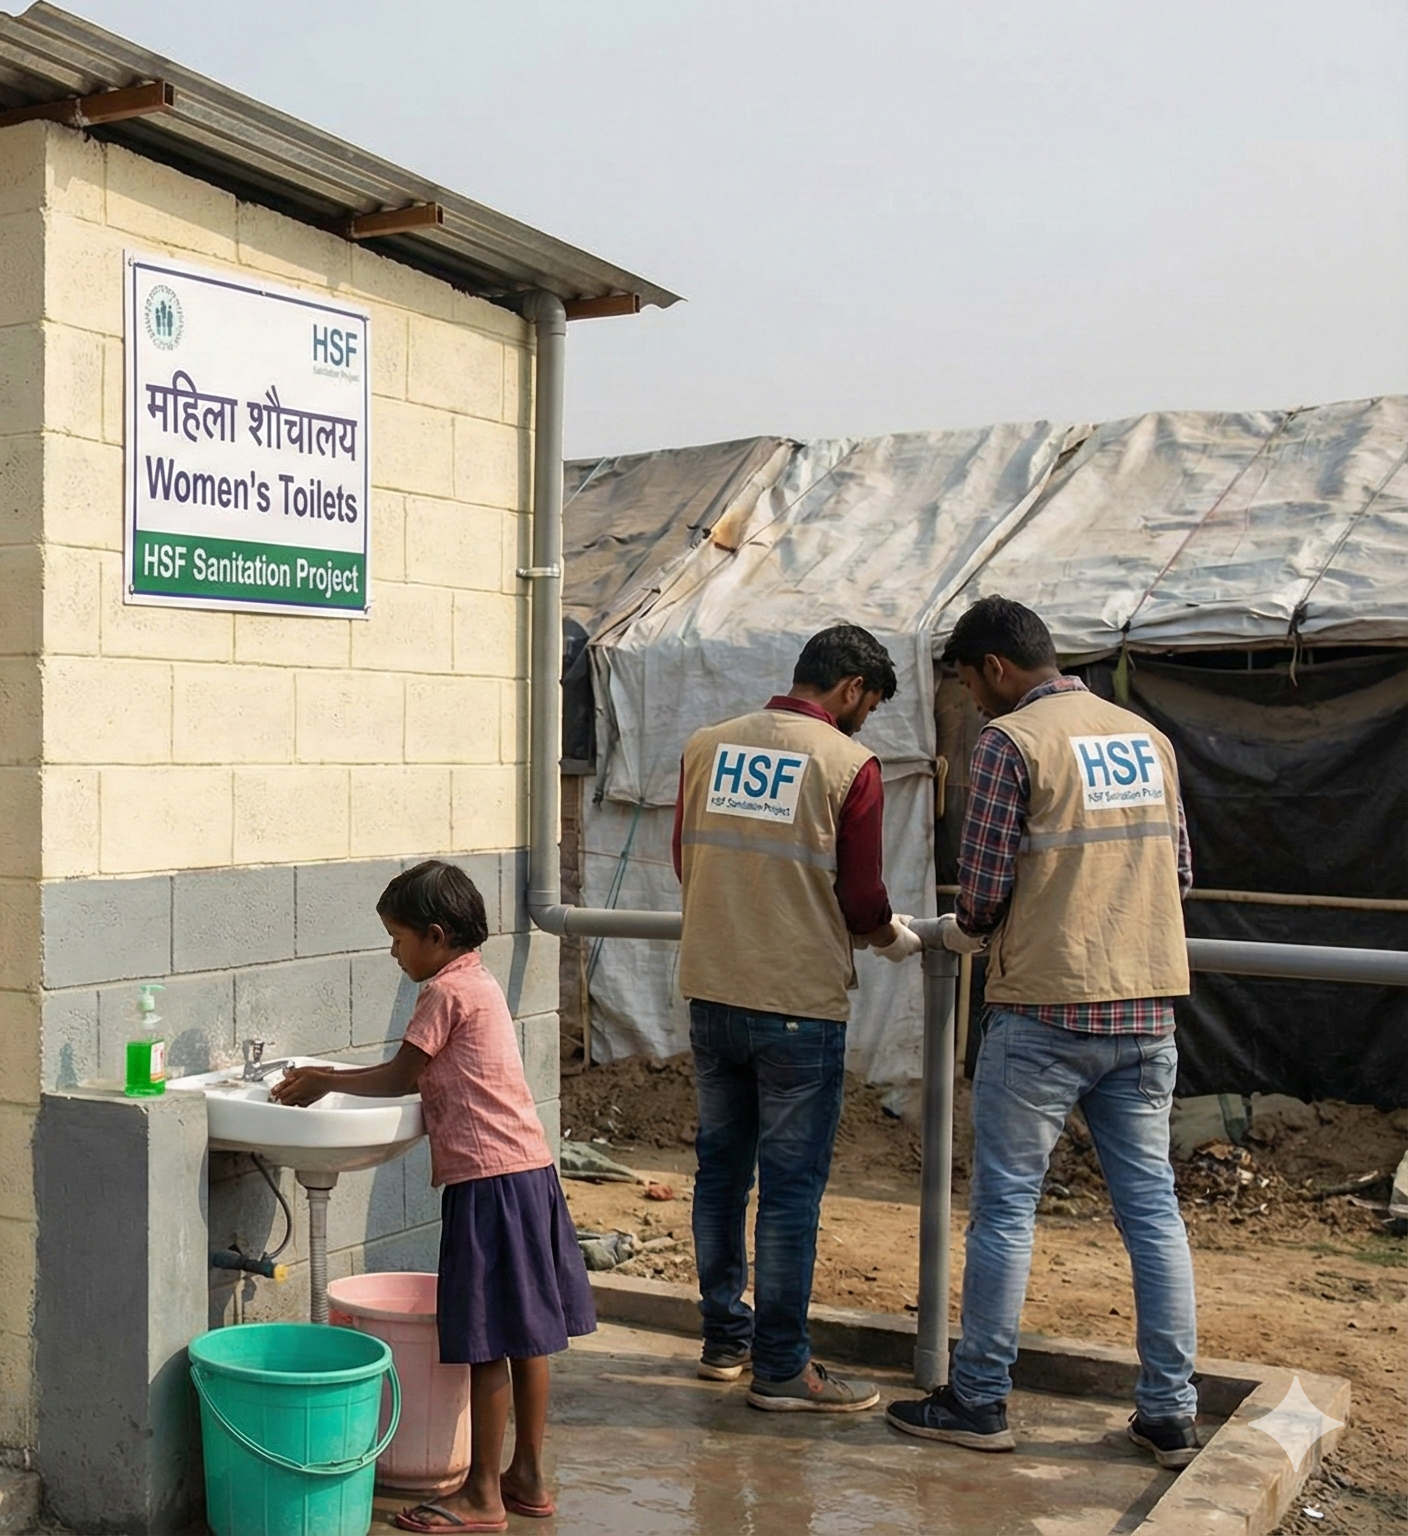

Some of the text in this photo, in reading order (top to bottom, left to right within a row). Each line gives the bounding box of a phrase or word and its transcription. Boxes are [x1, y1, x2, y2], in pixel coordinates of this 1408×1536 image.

[313, 324, 358, 368] HSF
[145, 370, 358, 461] महिला शौचालय
[145, 455, 358, 524] Women's Toilets
[143, 543, 359, 599] HSF Sanitation Project
[713, 751, 802, 799] HSF
[1078, 740, 1155, 787] HSF
